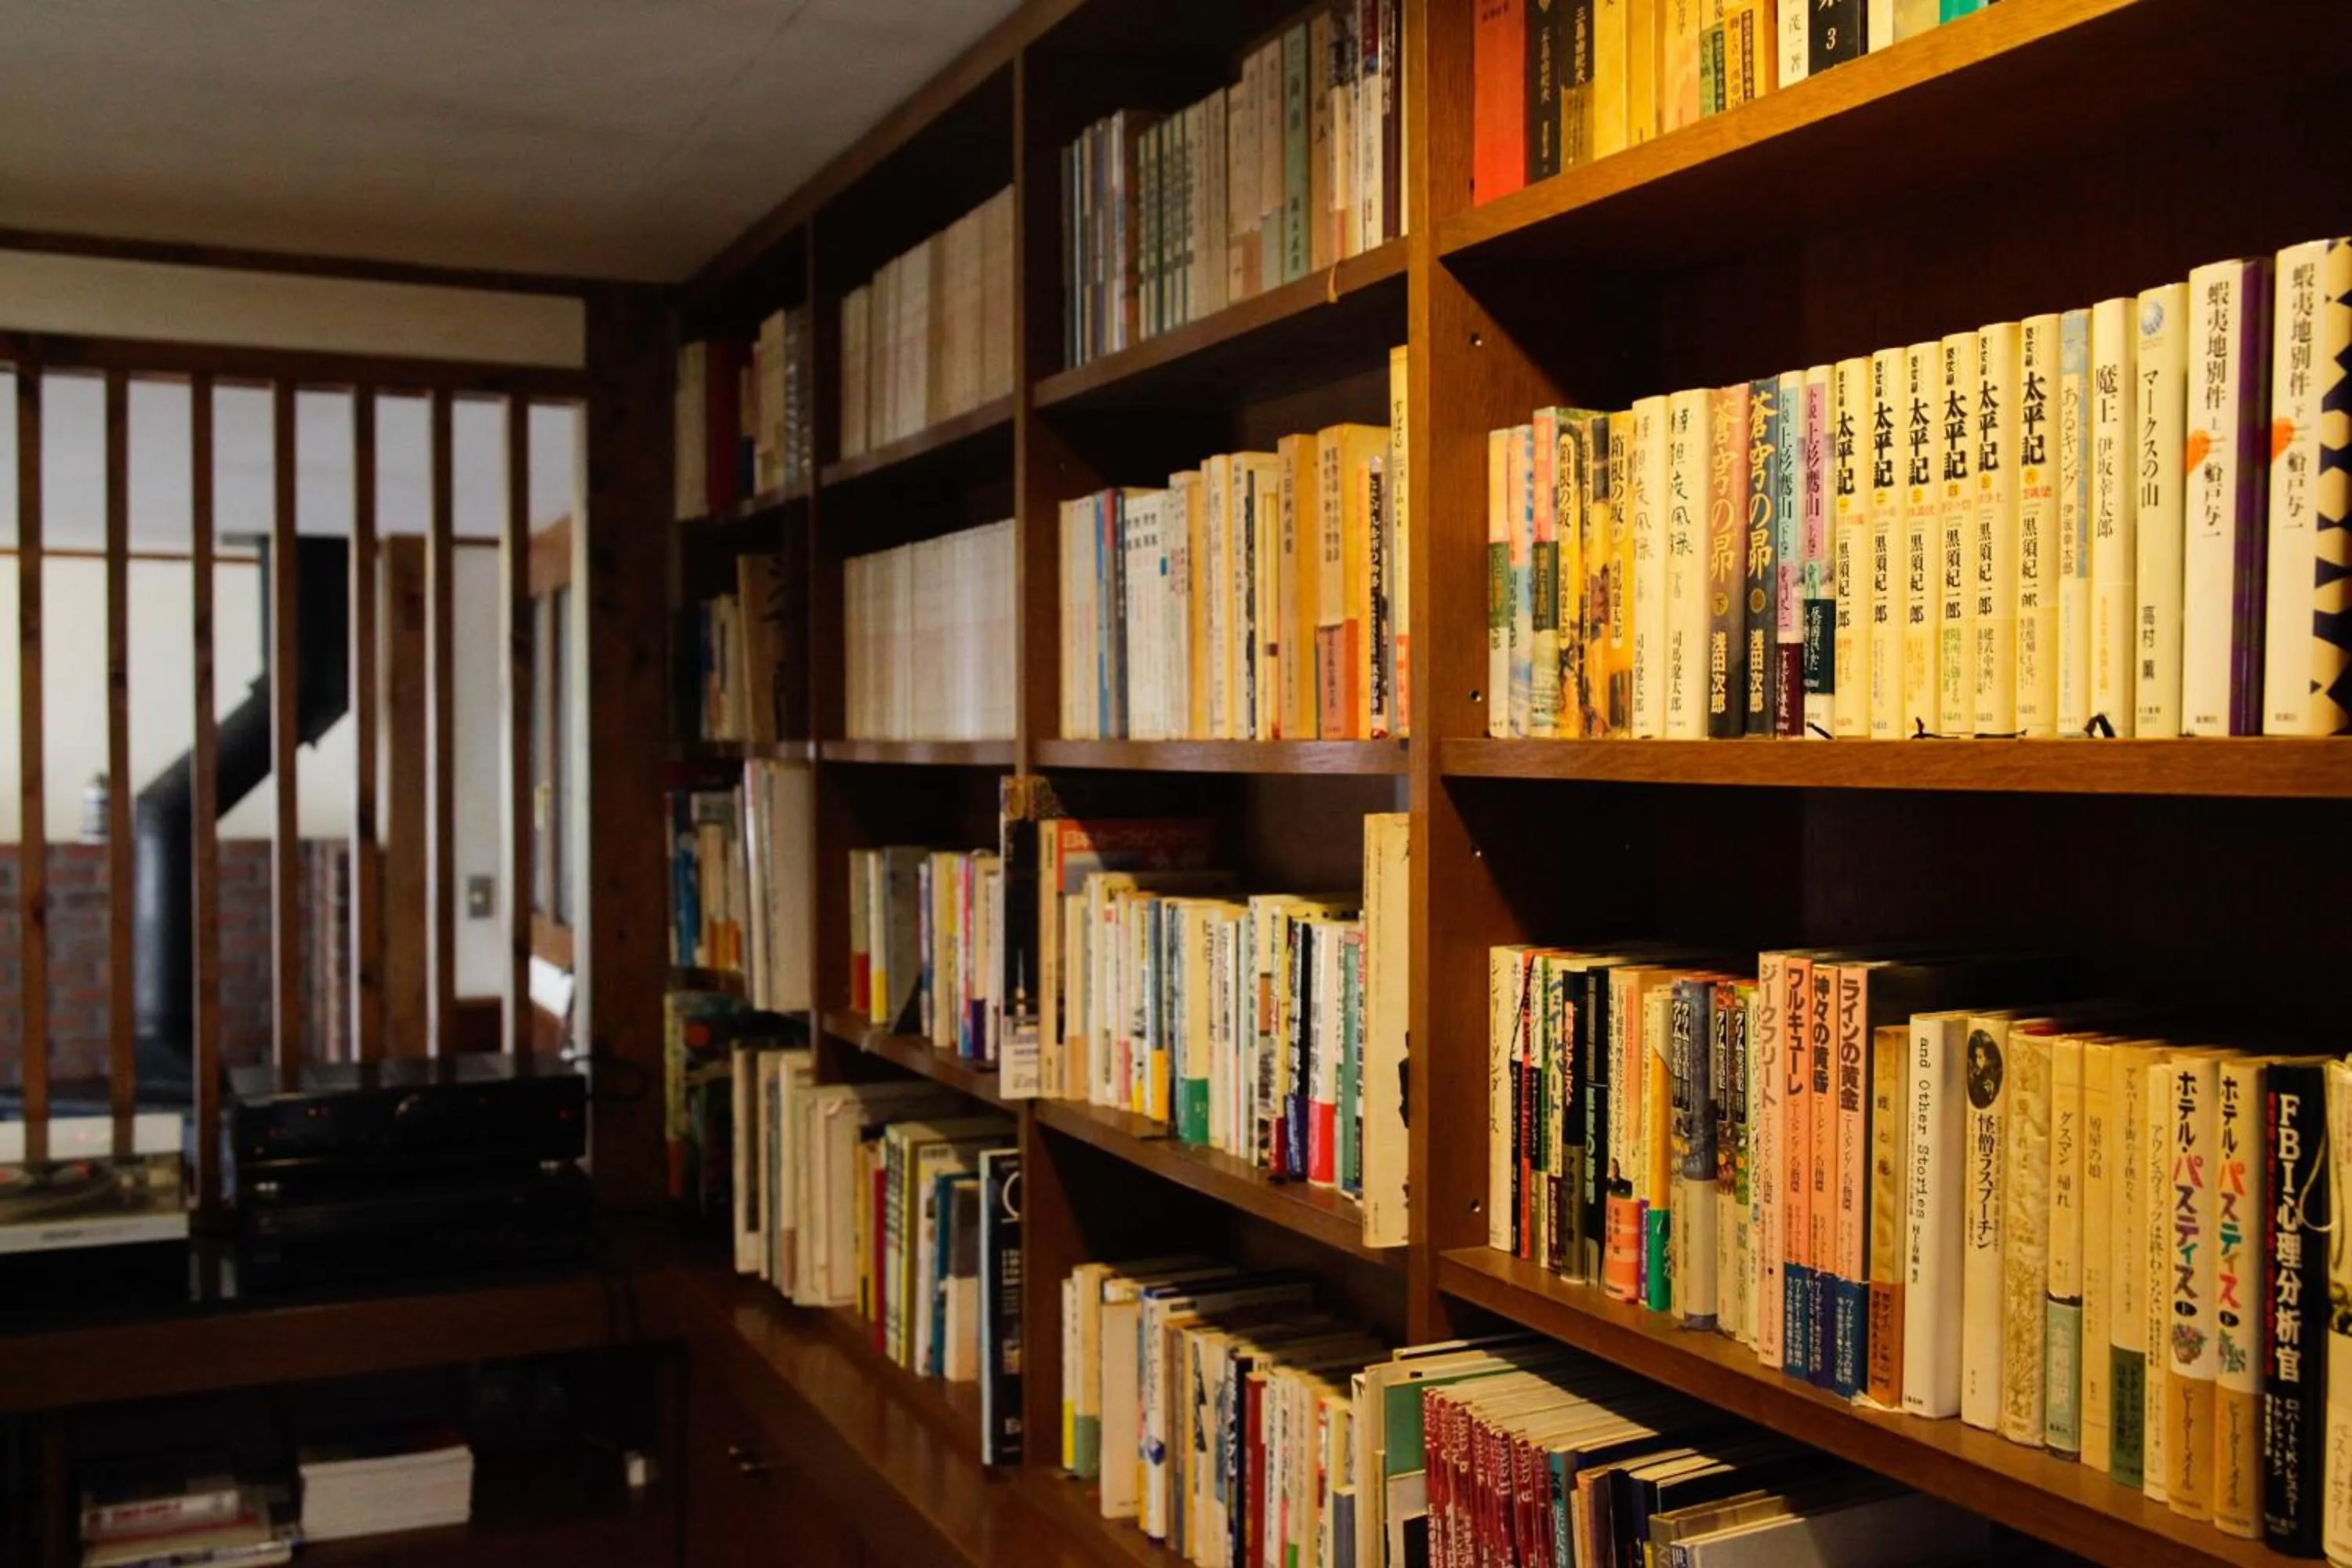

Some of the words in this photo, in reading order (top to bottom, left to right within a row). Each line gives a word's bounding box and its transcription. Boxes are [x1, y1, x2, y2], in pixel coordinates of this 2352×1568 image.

[1826, 27, 1837, 50] 3
[2205, 281, 2230, 411] 蝦夷地別件
[2289, 263, 2315, 398] 蝦夷地別件
[1944, 390, 1969, 481] 太平記
[1977, 380, 1999, 473] 太平記
[2021, 371, 2048, 467] 太平記
[2063, 387, 2078, 492] あるキング
[2096, 364, 2118, 424] 魔王
[2140, 369, 2159, 509] マークスの山
[1611, 434, 1625, 524] 箱根の坂
[1748, 392, 1779, 581] 蒼穹の昴
[1837, 411, 1856, 497] 太平記
[1874, 401, 1894, 489] 太平記
[1908, 397, 1930, 487] 太平記
[1710, 400, 1741, 584] 蒼穹の昴
[2096, 437, 2114, 539] 伊坂幸太郎
[2202, 461, 2224, 539] 船戸与一
[2285, 452, 2307, 530] 船戸与一
[1875, 535, 1887, 624] 黒須紀一郎
[1909, 534, 1924, 625] 黒須紀一郎
[1945, 528, 1961, 619] 黒須紀一郎
[1978, 521, 1992, 616] 黒須紀一郎
[2063, 503, 2074, 575] 伊坂幸太郎
[1838, 542, 1850, 628] 黒須紀一郎
[1711, 630, 1726, 714] 浅田次郎
[1749, 629, 1764, 713] 浅田次郎
[1761, 964, 1777, 1109] ジークフリート
[1787, 967, 1805, 1096] ワルキューレ
[1813, 975, 1830, 1095] 神々の黄昏
[1840, 978, 1861, 1113] ラインの黄金
[1919, 1036, 1931, 1069] and
[1918, 1080, 1932, 1136] Other
[1915, 1143, 1931, 1220] Stories
[1976, 1112, 1996, 1250] 怪僧ラスプーチン
[2173, 1071, 2204, 1300] ホテル・パスティス
[2218, 1076, 2246, 1310] ホテル・パスティス
[2276, 1093, 2303, 1383] FBI心理分析官
